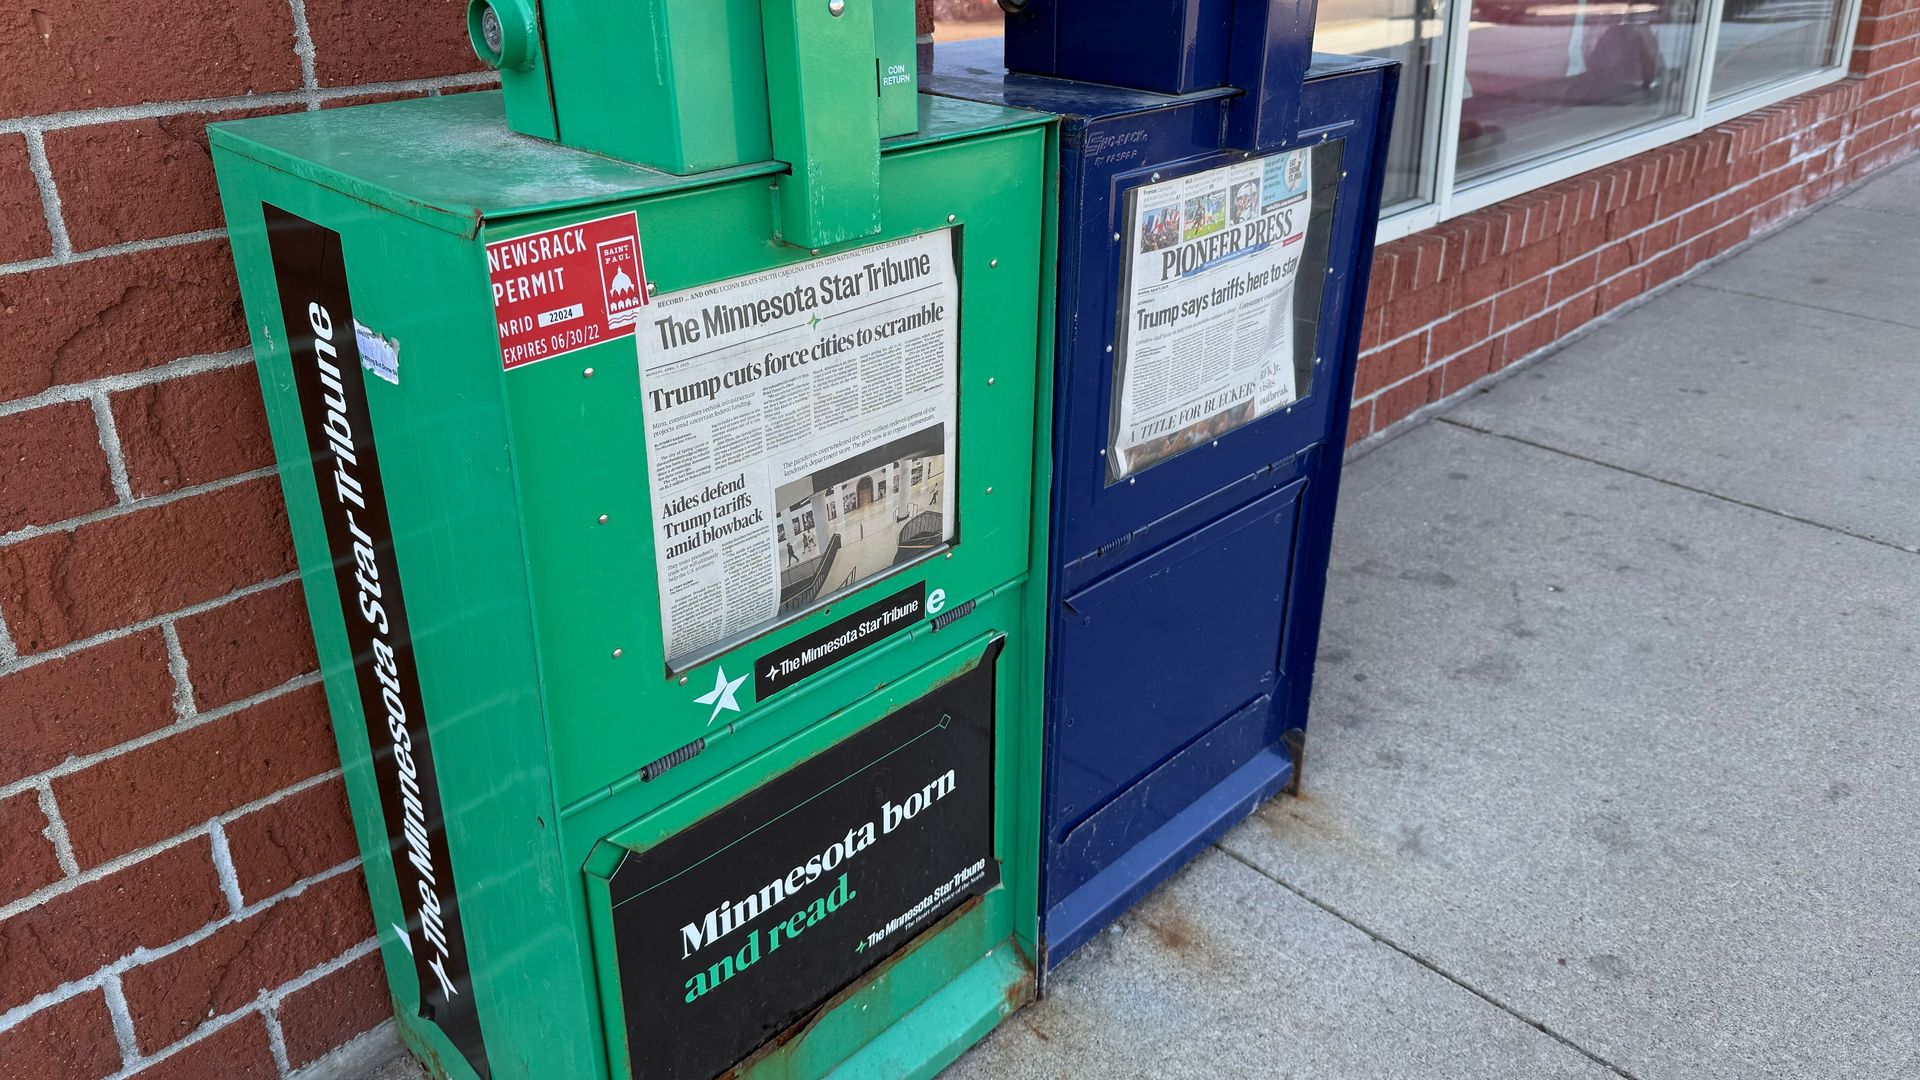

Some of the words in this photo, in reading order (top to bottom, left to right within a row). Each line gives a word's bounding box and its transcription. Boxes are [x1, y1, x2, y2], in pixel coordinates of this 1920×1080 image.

[883, 74, 910, 86] RETURN
[888, 64, 905, 75] COIN
[486, 228, 587, 273] NEWSRACK
[604, 245, 629, 256] SAINT
[605, 253, 631, 264] PAUL
[1161, 229, 1242, 282] PIONEER
[1243, 208, 1293, 249] PRESS
[492, 267, 564, 307] PERMIT
[654, 314, 700, 350] The
[701, 283, 819, 340] Minnesota
[819, 271, 863, 305] Star
[862, 253, 931, 292] Tribune
[657, 296, 684, 308] RECORD
[690, 290, 704, 300] AND
[758, 272, 778, 283] SOUTH
[1137, 304, 1179, 331] Trump
[1181, 294, 1209, 318] says
[1211, 276, 1245, 307] tariffs
[1246, 272, 1269, 293] here
[1271, 264, 1281, 282] to
[1282, 256, 1299, 278] stay
[499, 316, 533, 338] NRID
[550, 308, 573, 323] 22024
[504, 338, 547, 364] EXPIRES
[551, 324, 600, 350] 06/30/22
[649, 375, 721, 413] Trump
[723, 362, 763, 390] cuts
[764, 345, 809, 378] force
[811, 333, 855, 361] cities
[856, 326, 873, 347] to
[874, 302, 944, 341] scramble
[308, 301, 365, 509] Tribune
[1128, 430, 1136, 442] A
[1140, 415, 1177, 439] TITLE
[1179, 404, 1201, 425] FOR
[1204, 381, 1256, 414] BUECKERS
[783, 460, 794, 469] The
[662, 495, 700, 519] Aides
[701, 473, 746, 503] defend
[663, 511, 711, 539] Trump
[714, 492, 752, 520] tariffs
[666, 531, 702, 560] amid
[702, 508, 764, 545] blowback
[346, 509, 389, 635] Star
[926, 588, 946, 614] e
[780, 653, 800, 678] The
[801, 629, 858, 666] Minnesota
[858, 617, 882, 639] Star
[882, 598, 919, 626] Tribune
[372, 638, 436, 886] Minnesota
[680, 821, 876, 960] Minnesota
[881, 769, 956, 835] born
[418, 880, 449, 958] The
[867, 929, 885, 948] The
[885, 894, 933, 936] Minnesota
[933, 879, 954, 901] Star
[953, 858, 985, 887] Tribune
[905, 921, 916, 931] The
[915, 909, 931, 923] Heart
[930, 902, 941, 912] and
[970, 871, 985, 883] North
[684, 927, 762, 1004] and
[768, 872, 857, 955] read.
